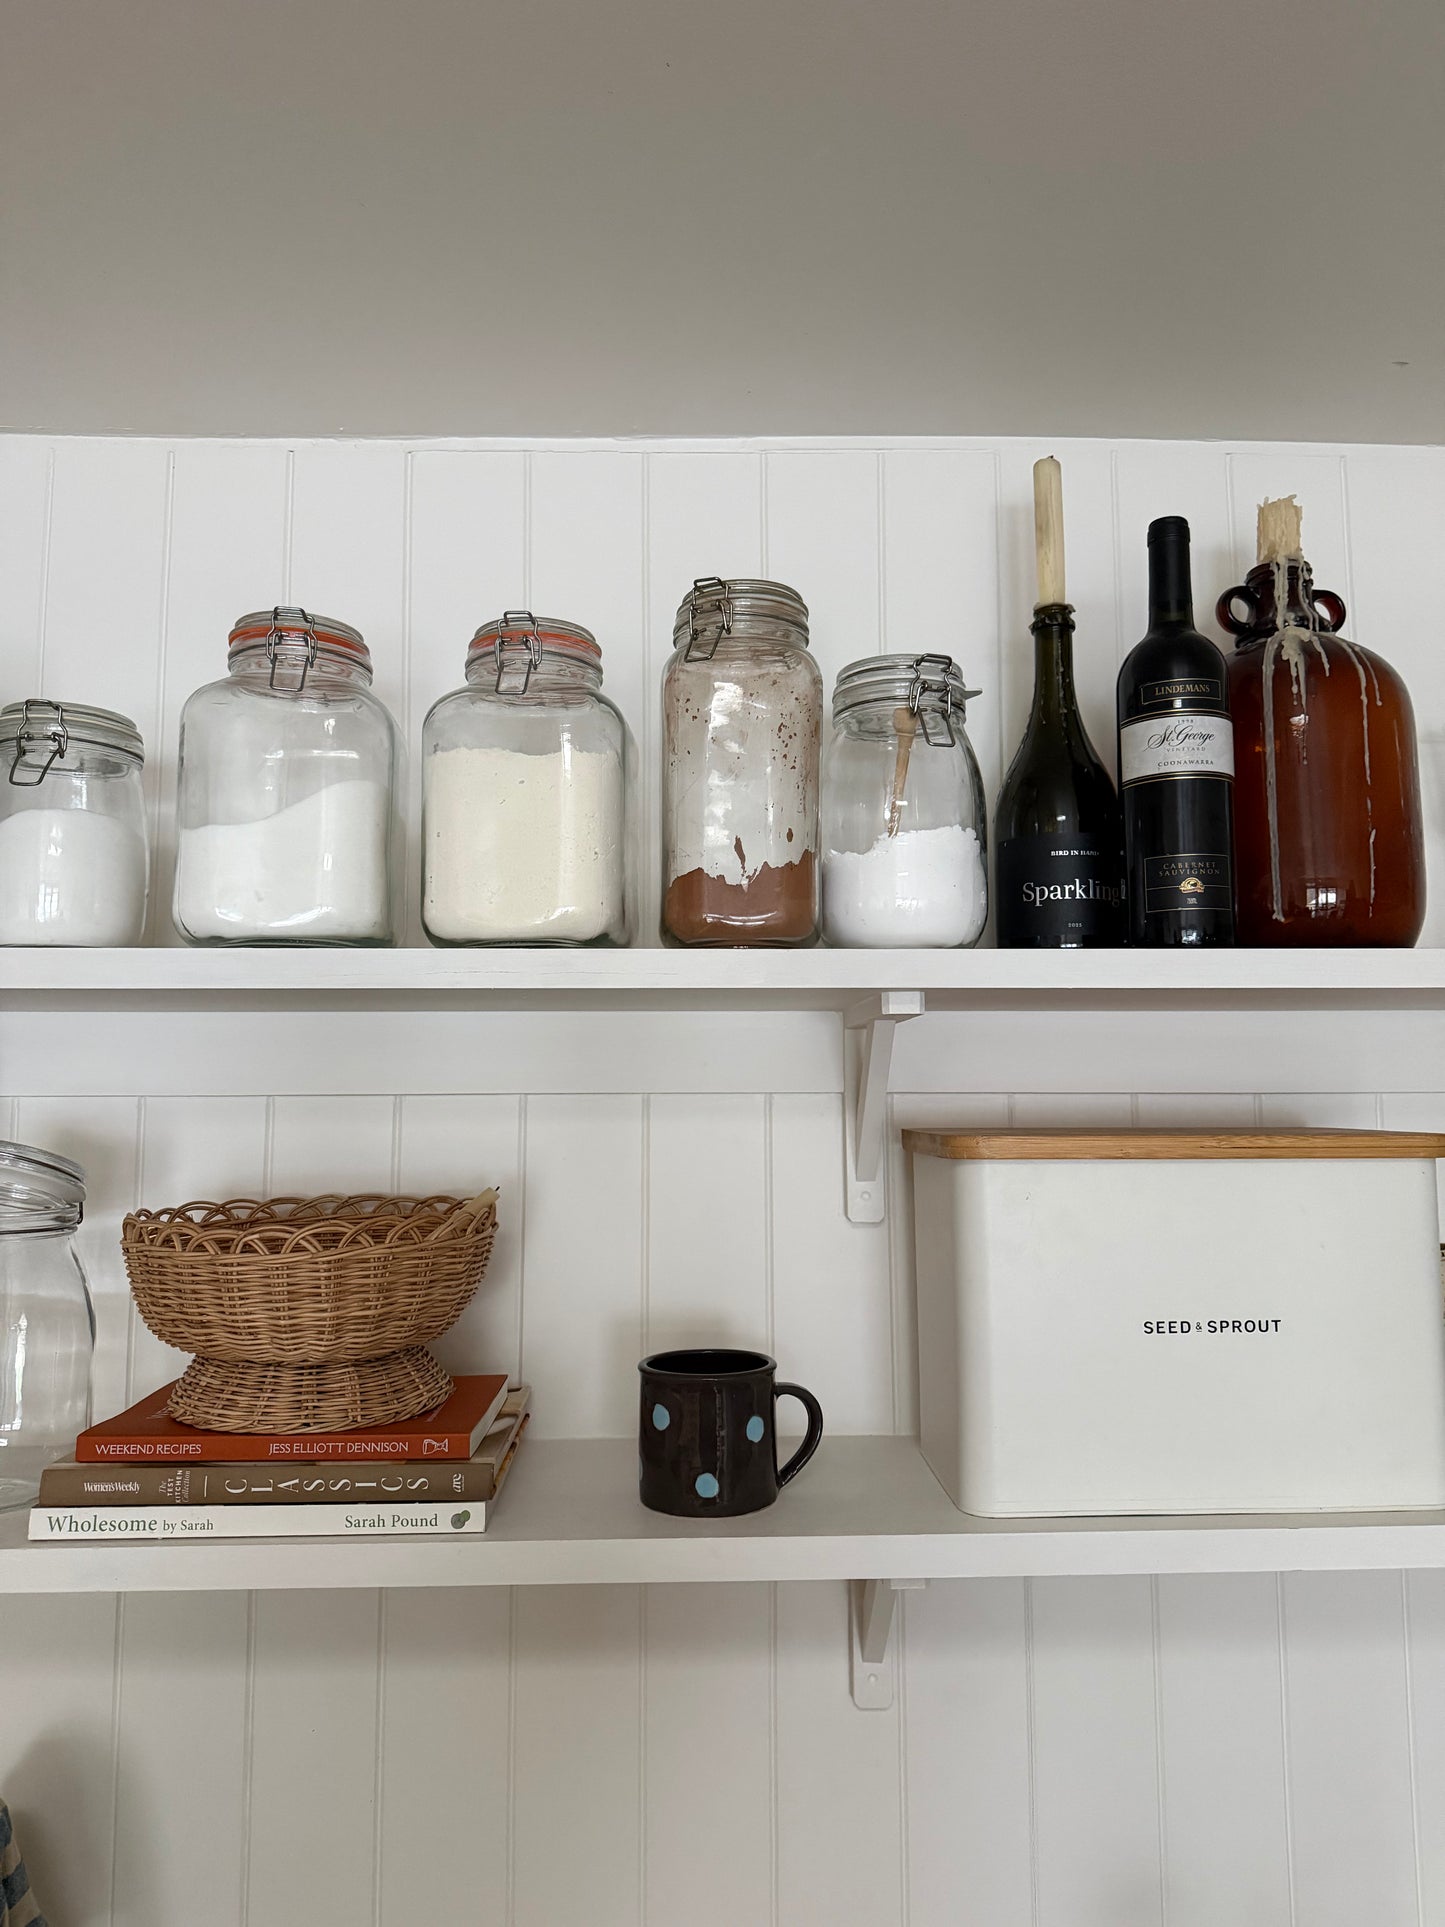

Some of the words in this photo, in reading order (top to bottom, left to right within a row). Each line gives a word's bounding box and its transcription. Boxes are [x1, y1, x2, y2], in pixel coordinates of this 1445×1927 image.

[1154, 683, 1210, 696] LINDEMANS
[1167, 723, 1216, 747] George
[1157, 759, 1214, 768] COONAWARRA
[1159, 867, 1220, 877] SAUVIGNON
[1163, 861, 1216, 870] CABERNET
[1022, 878, 1121, 908] Sparkling
[1143, 1320, 1191, 1334] SEED
[1195, 1321, 1203, 1333] &
[1207, 1319, 1282, 1334] SPROUT
[95, 1444, 154, 1455] WEEKEND
[156, 1443, 202, 1454] RECIPES
[269, 1443, 291, 1456] JESS
[293, 1442, 345, 1454] ELLIOTT
[347, 1441, 409, 1453] DENNISON
[175, 1469, 183, 1503] KITCHEN
[182, 1470, 191, 1503] Collection
[224, 1476, 429, 1495] CLASSICS
[47, 1515, 158, 1533] Wholesome
[162, 1519, 177, 1534] by
[180, 1519, 214, 1531] Sarah
[344, 1514, 386, 1528] Sarah
[391, 1513, 439, 1528] Pound
